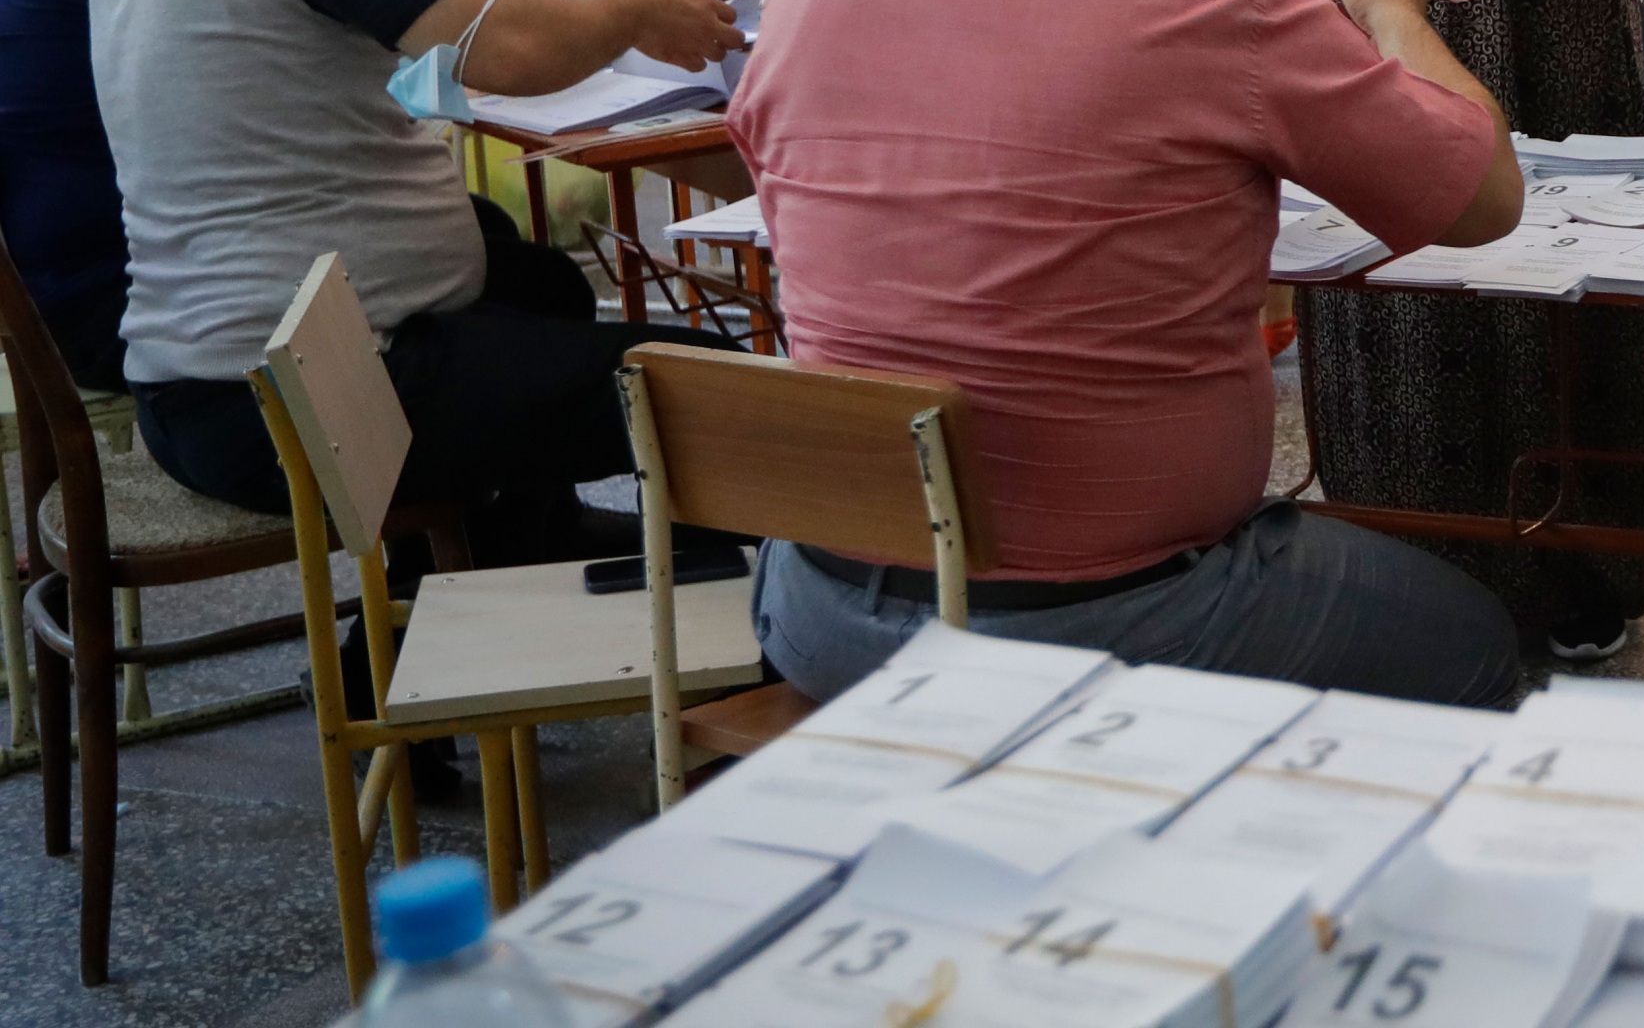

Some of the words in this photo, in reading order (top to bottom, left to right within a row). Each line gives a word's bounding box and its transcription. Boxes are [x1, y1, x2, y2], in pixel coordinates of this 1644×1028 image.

[1529, 184, 1569, 196] 19
[1315, 218, 1346, 231] 7
[1550, 237, 1580, 248] 9
[887, 673, 935, 704] 1
[1068, 710, 1137, 747] 2
[1283, 737, 1339, 771] 3
[1508, 748, 1561, 784] 4
[526, 891, 642, 946] 12
[1004, 906, 1118, 967] 14
[800, 919, 911, 978] 13
[1332, 942, 1444, 1021] 15
